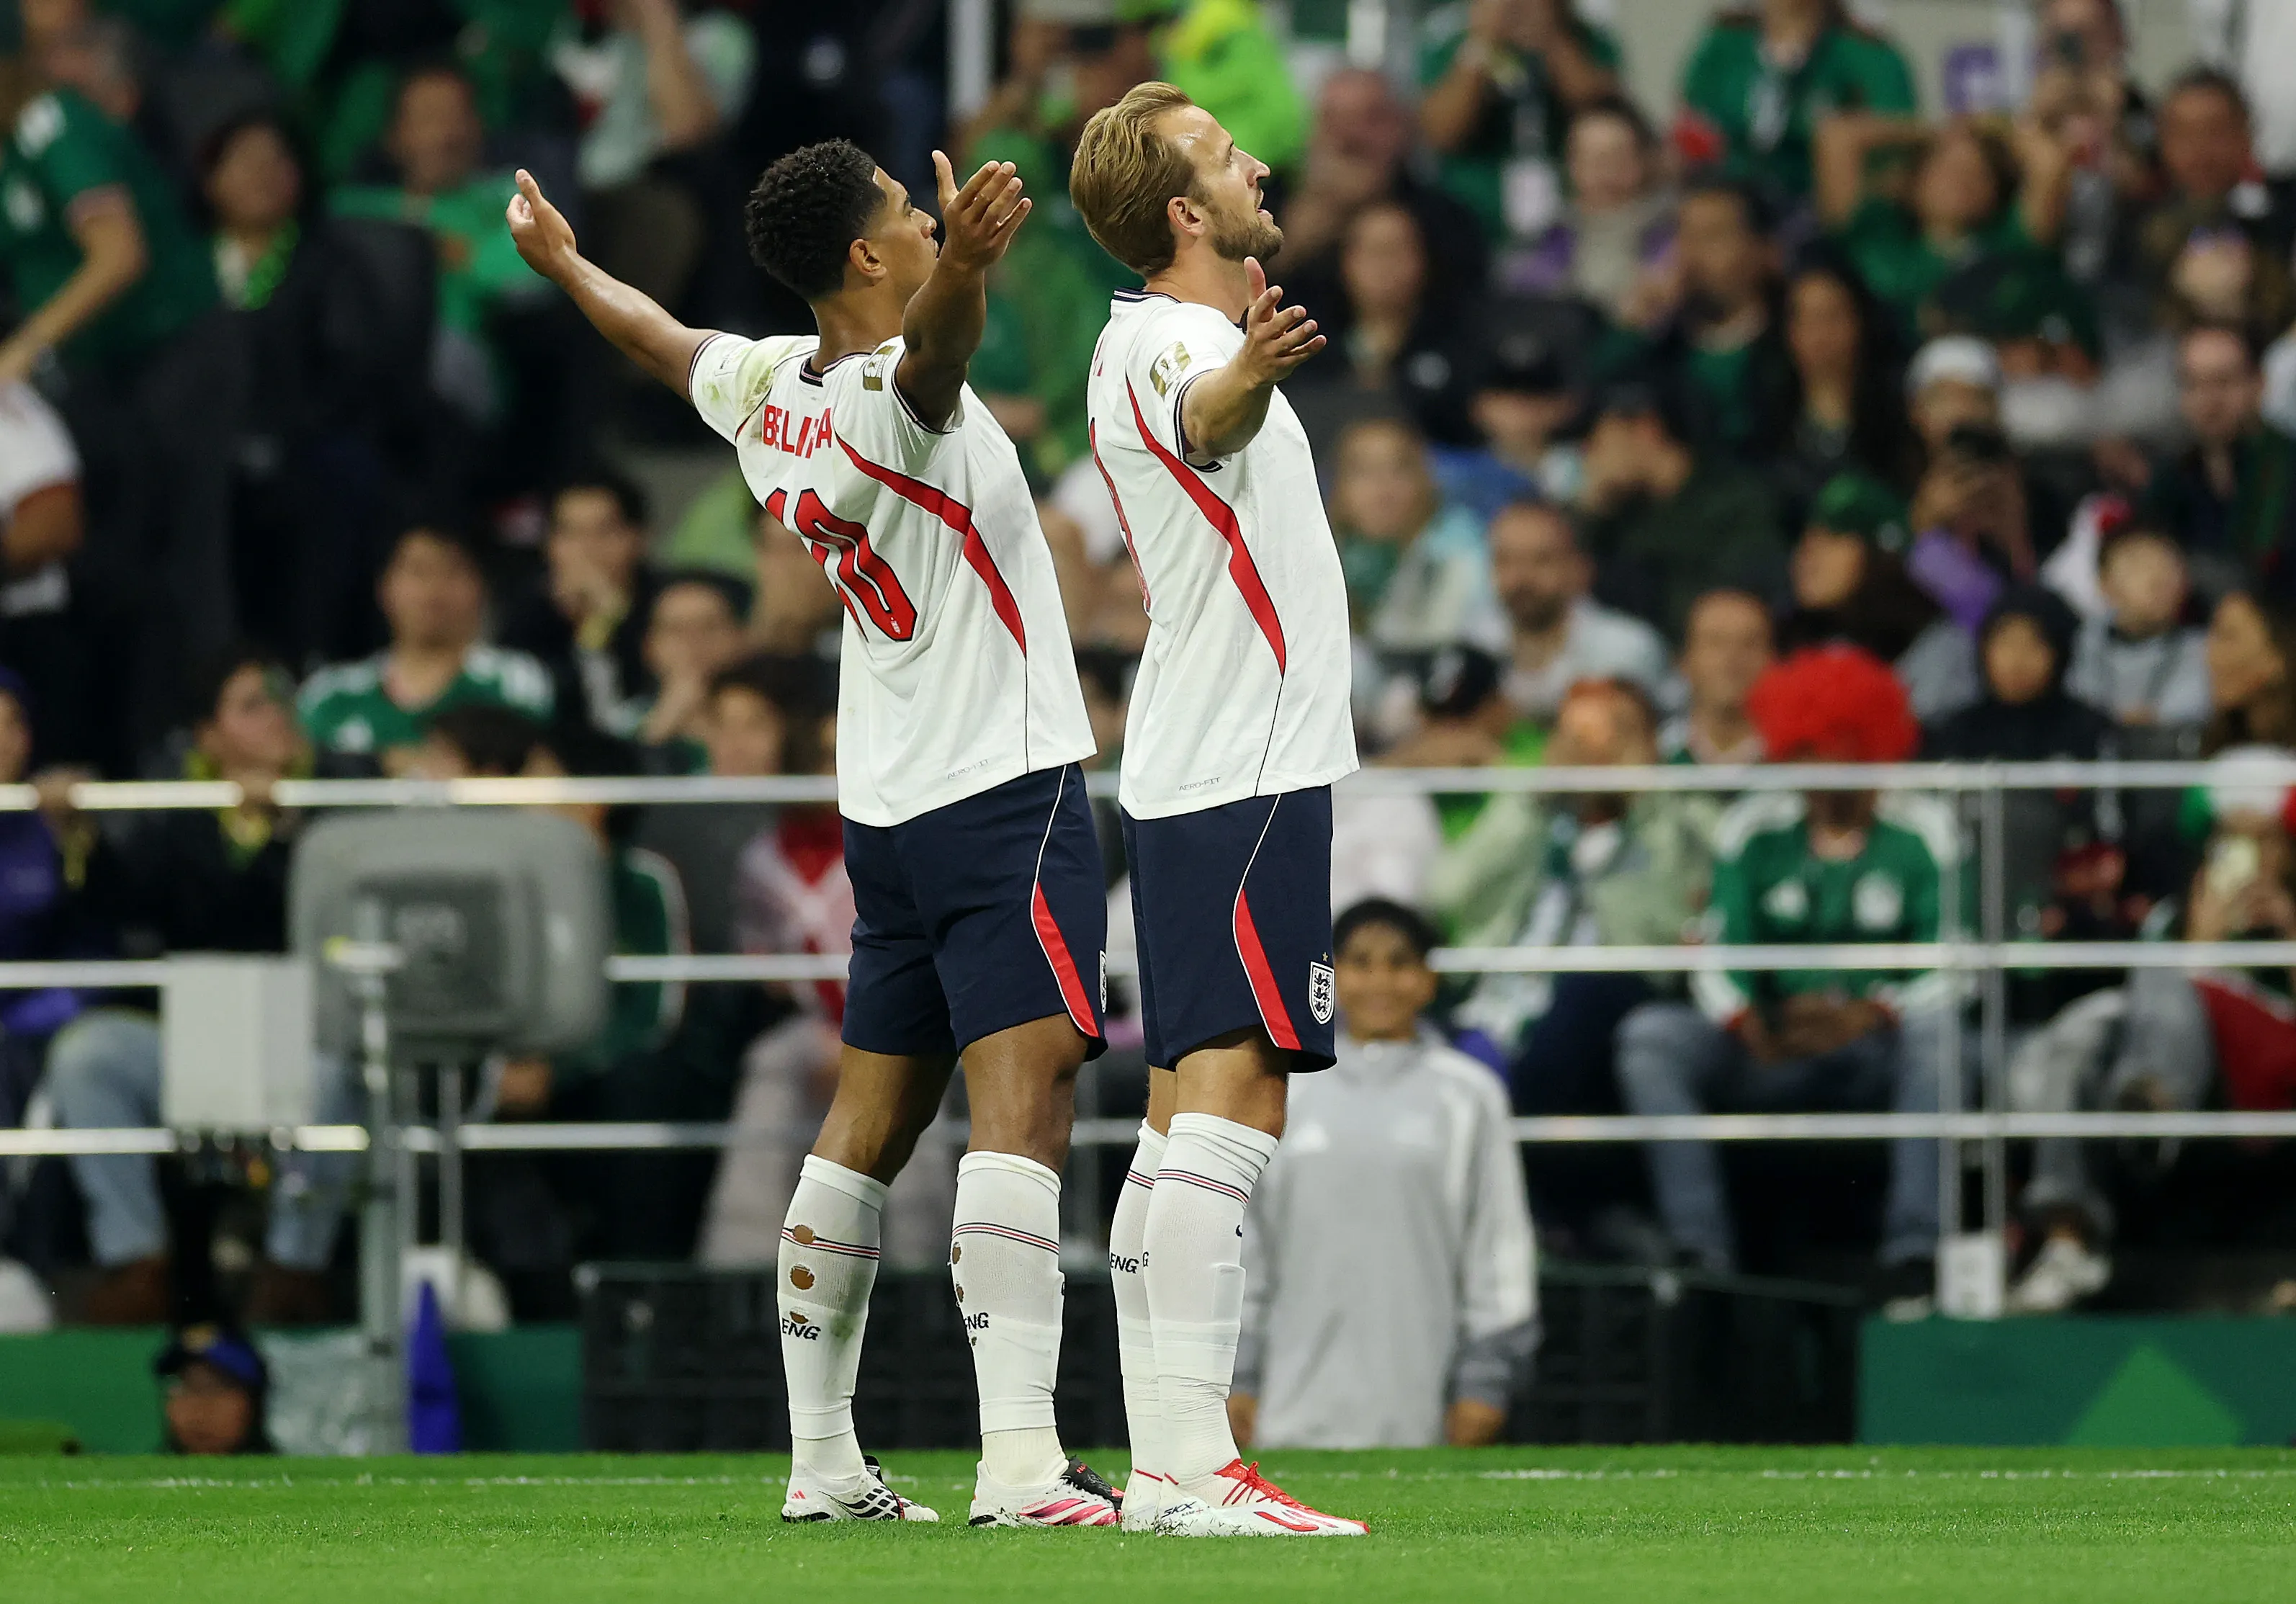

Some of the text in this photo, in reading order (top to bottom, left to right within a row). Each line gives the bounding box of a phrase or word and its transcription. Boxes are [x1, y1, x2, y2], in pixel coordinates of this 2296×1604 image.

[1178, 776, 1221, 791] AERO-FIT
[1109, 1252, 1139, 1274] ENG
[781, 1317, 822, 1341] ENG
[1160, 1500, 1197, 1519] SKX
